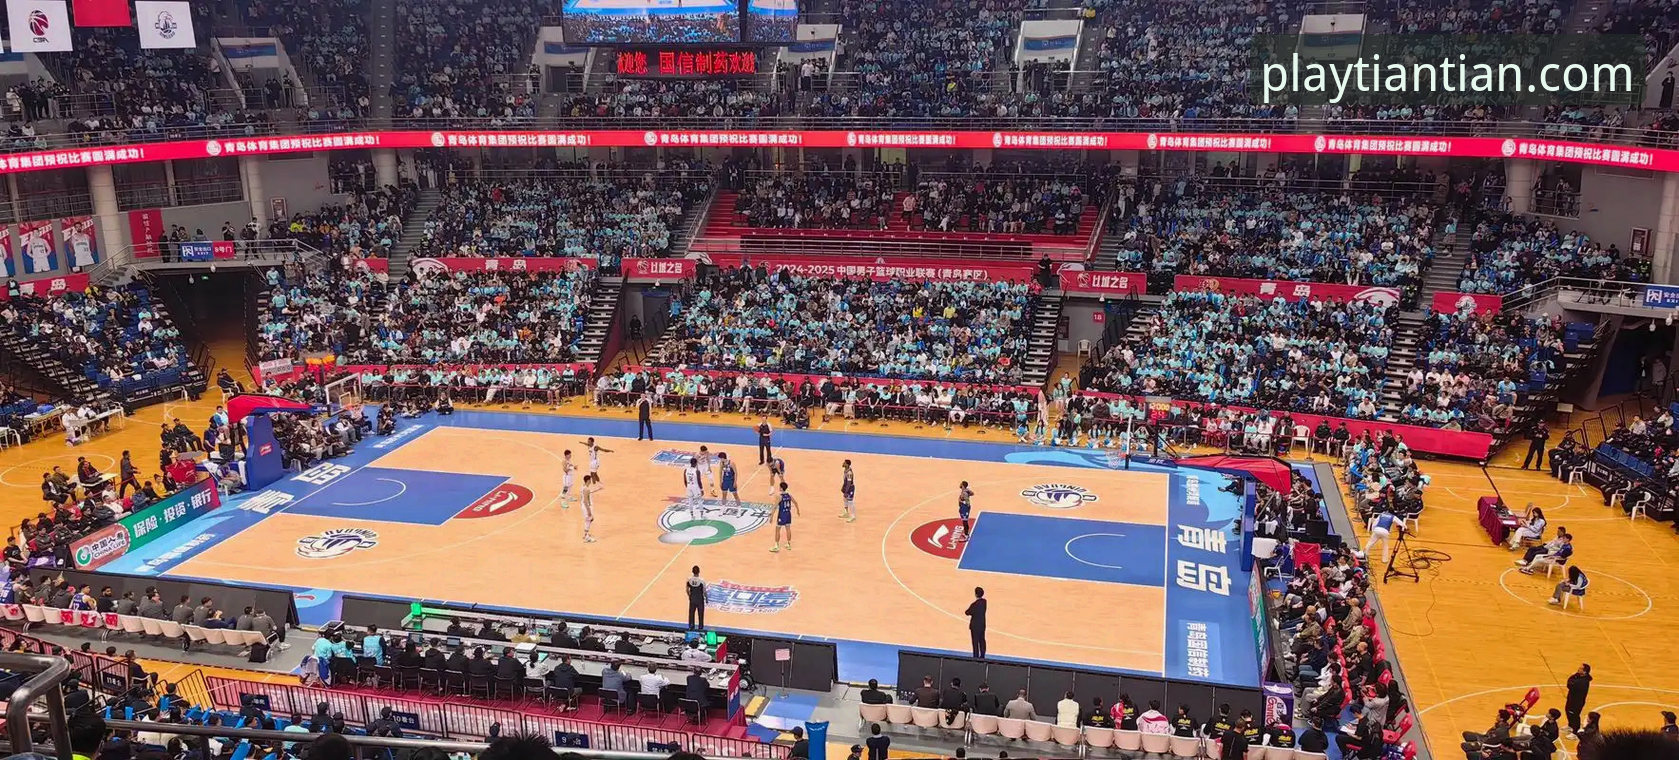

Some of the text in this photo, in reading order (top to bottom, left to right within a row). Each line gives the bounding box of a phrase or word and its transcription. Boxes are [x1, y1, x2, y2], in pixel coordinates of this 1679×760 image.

[659, 51, 756, 75] 国信制药欢迎
[224, 136, 381, 153] 青岛体育集团预祝比赛圆满成功！
[447, 134, 591, 146] 青岛体育集团预祝比赛圆满成功！
[660, 134, 803, 145] 青岛体育集团预祝比赛圆满成功！
[857, 134, 956, 145] 青岛体育集团预祝比赛圆满成功！
[1004, 135, 1108, 147] 青岛体育集团预祝比赛圆满成功！
[1159, 136, 1272, 149] 青岛体育集团预祝比赛圆满成功！
[1328, 138, 1452, 152] 青岛体育集团预祝比赛圆满成功！
[1518, 143, 1654, 165] 青岛体育集团预祝比赛圆满成功！
[1176, 524, 1232, 597] 青岛
